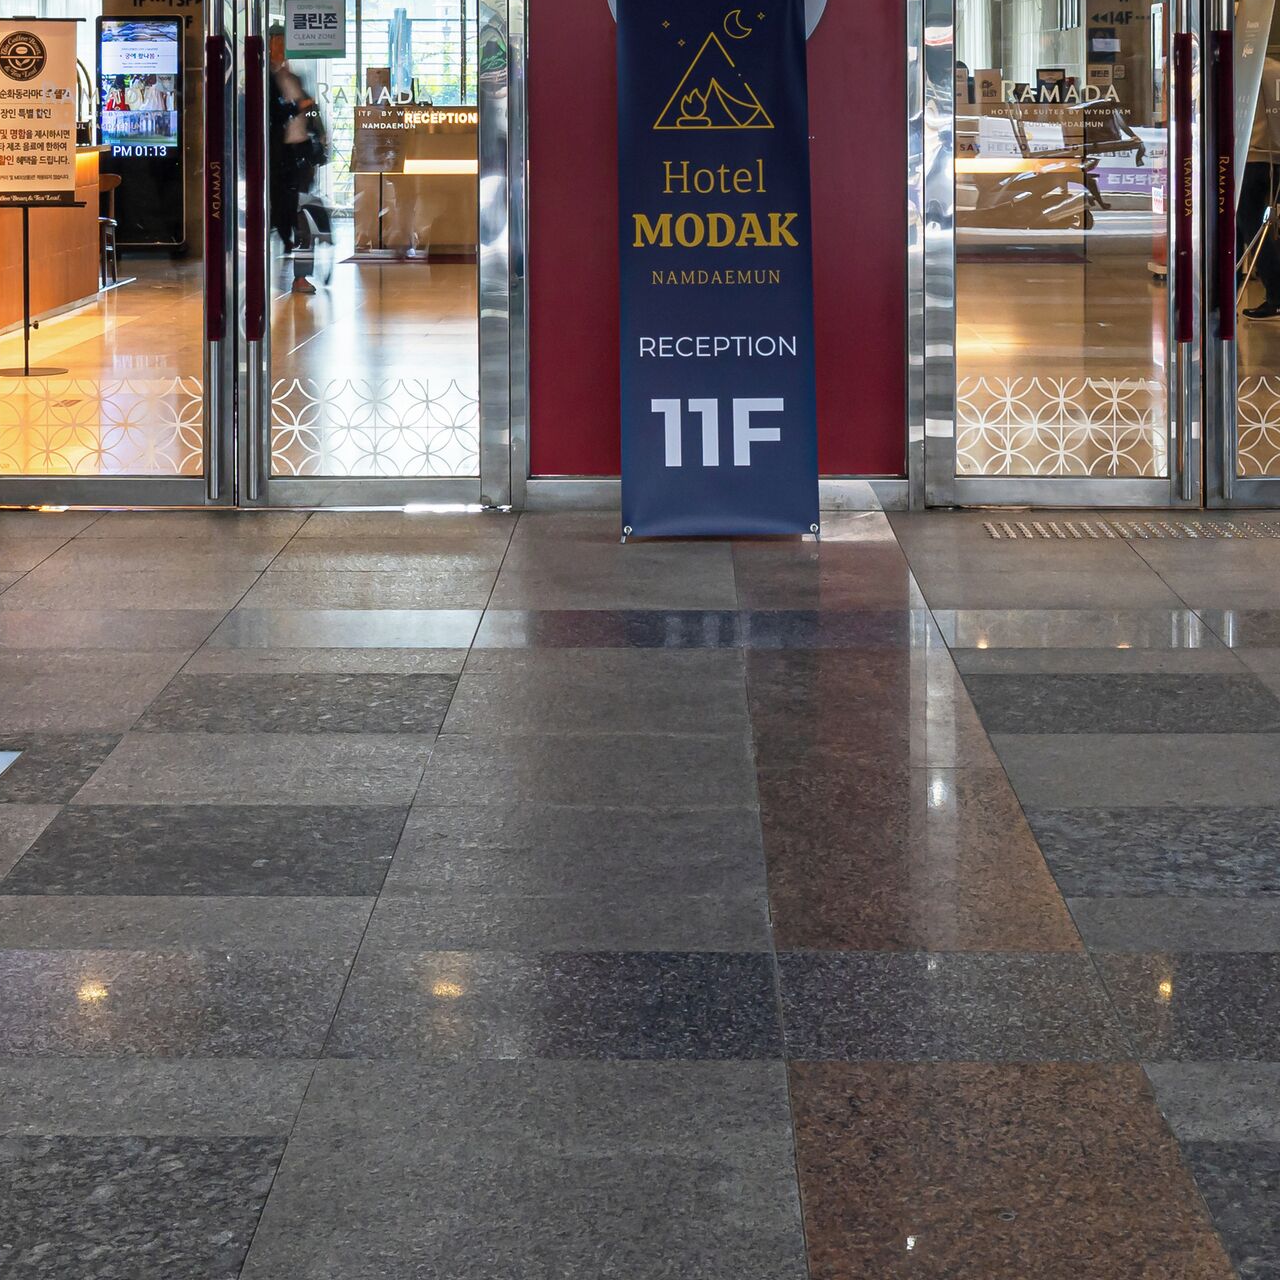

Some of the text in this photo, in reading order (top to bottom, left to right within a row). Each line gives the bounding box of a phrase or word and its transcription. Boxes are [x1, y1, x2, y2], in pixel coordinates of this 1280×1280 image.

[293, 13, 338, 30] 클린존
[315, 82, 433, 105] RAMADA
[1001, 80, 1120, 103] RAMADA
[18, 108, 33, 119] 특별
[35, 108, 51, 119] 할인
[404, 112, 478, 124] RECEPTION
[0, 128, 71, 139] 및 명함을 제시하시면
[6, 142, 21, 151] 제조
[23, 142, 45, 152] 음료에
[46, 142, 67, 151] 한하여
[113, 146, 167, 157] PM 01:13
[16, 155, 37, 165] 혜택을
[39, 156, 71, 165] 드립니다.
[662, 159, 766, 193] Hotel
[1219, 156, 1230, 214] RAMADA
[632, 213, 799, 247] MODAK
[651, 270, 781, 285] NAMDAEMUN
[639, 336, 797, 357] RECEPTION
[651, 397, 784, 467] 11F
